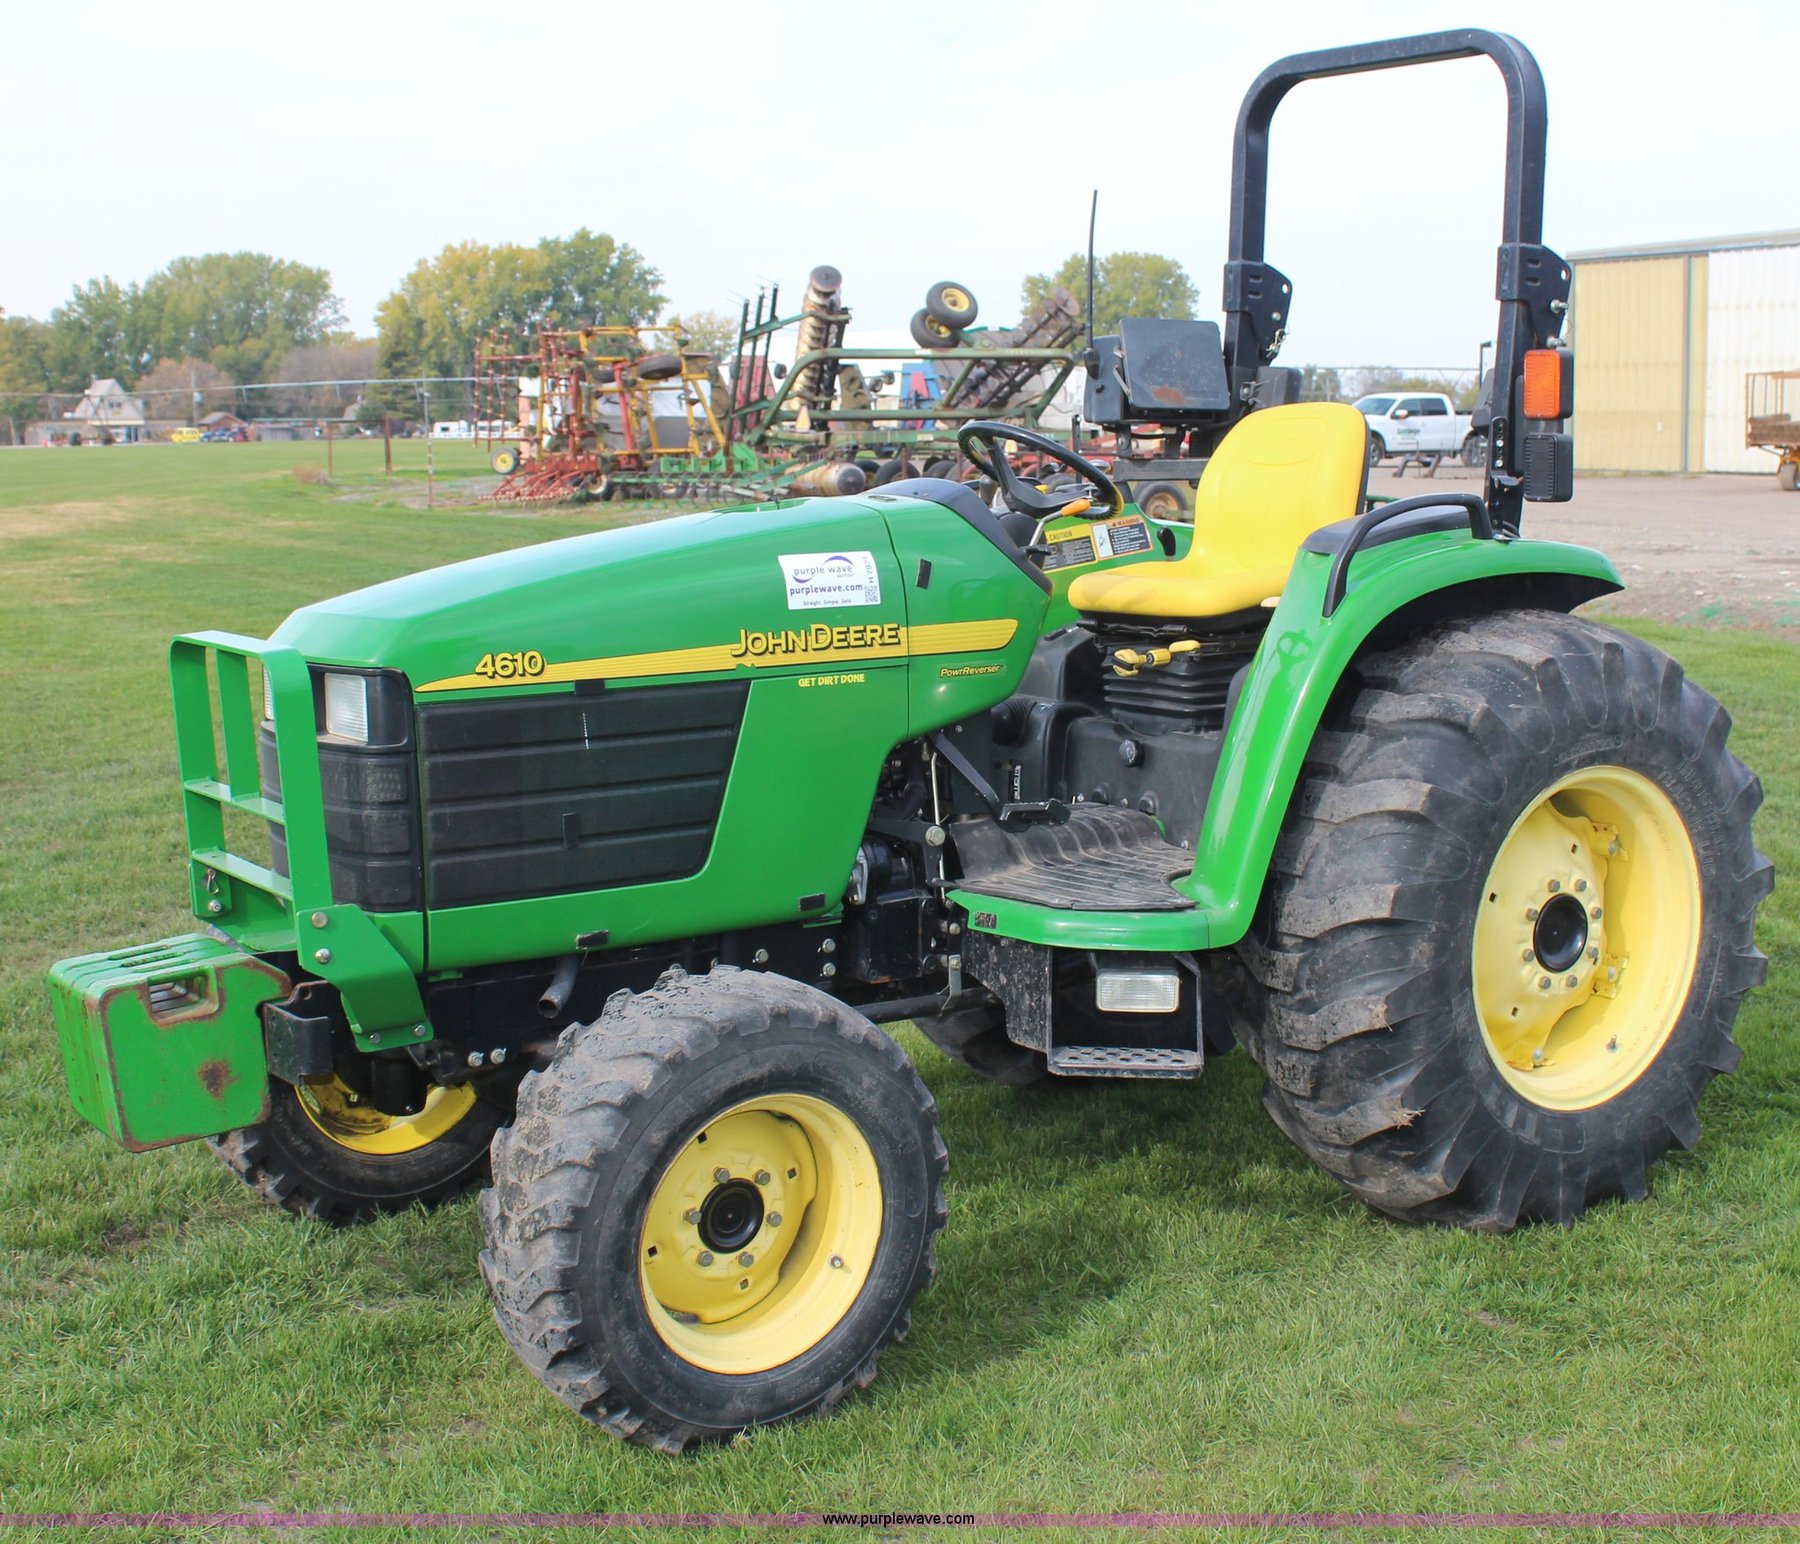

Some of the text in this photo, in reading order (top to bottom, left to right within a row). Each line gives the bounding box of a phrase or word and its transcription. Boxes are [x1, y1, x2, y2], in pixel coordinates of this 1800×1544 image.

[1049, 531, 1073, 541] CAUTION
[793, 565, 853, 576] purple wave
[789, 584, 864, 596] purplewave.com
[475, 650, 545, 679] 4610
[940, 664, 1001, 678] PowrReverser
[798, 674, 865, 687] GET DIRT DONE
